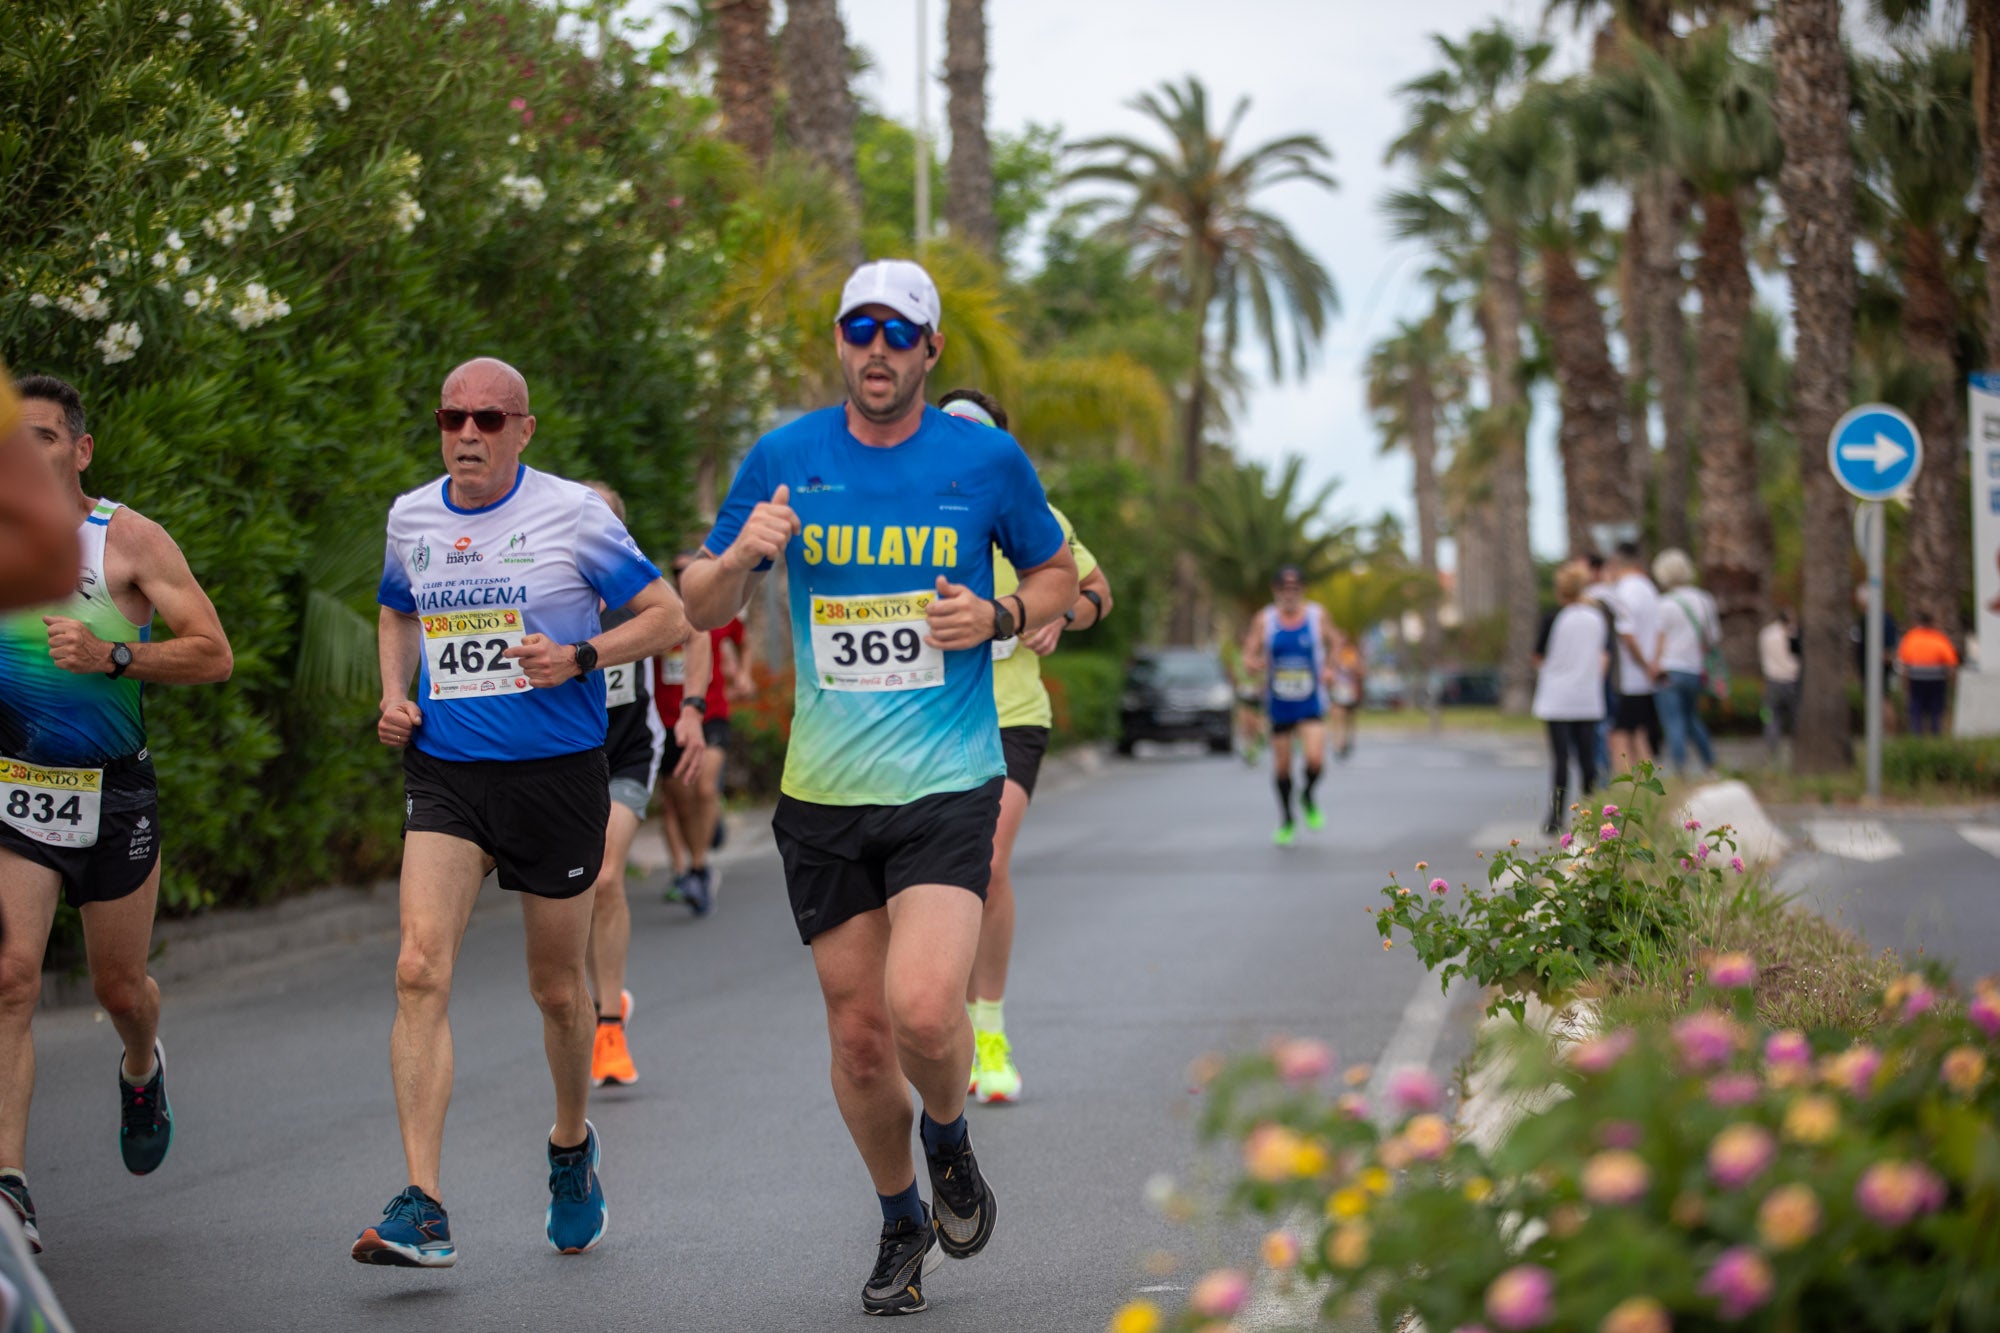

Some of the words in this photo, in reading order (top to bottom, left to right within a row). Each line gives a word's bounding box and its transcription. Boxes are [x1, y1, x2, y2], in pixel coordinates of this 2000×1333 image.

[803, 524, 958, 568] SULAYR
[446, 551, 484, 566] mayfo
[423, 581, 443, 590] CLUB
[445, 580, 457, 588] DE
[459, 577, 511, 587] ATLETISMO
[416, 586, 528, 611] MARACENA
[826, 603, 845, 619] 38
[845, 604, 911, 619] FONDO
[435, 617, 449, 632] 38
[448, 617, 500, 632] FONDO
[831, 628, 921, 667] 369
[439, 638, 512, 675] 462
[10, 765, 28, 779] 38
[27, 771, 79, 786] FONDO
[6, 789, 82, 826] 834
